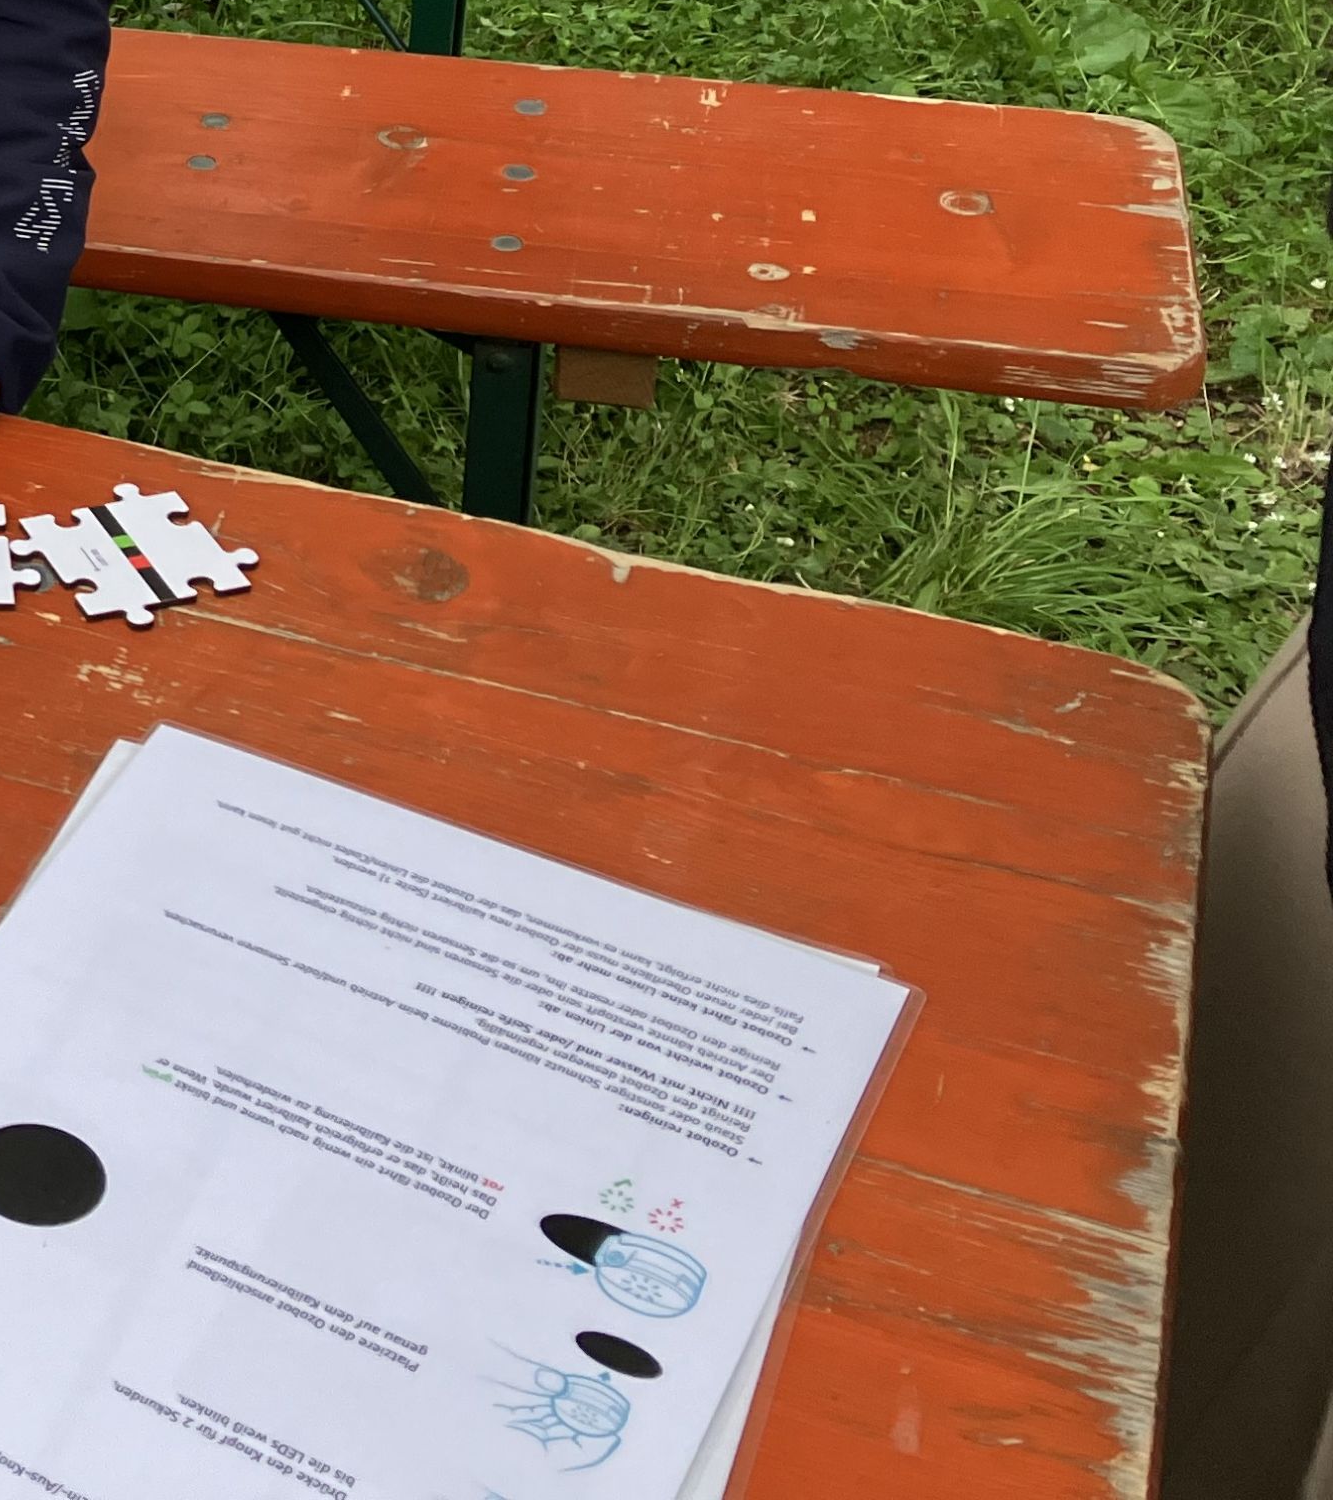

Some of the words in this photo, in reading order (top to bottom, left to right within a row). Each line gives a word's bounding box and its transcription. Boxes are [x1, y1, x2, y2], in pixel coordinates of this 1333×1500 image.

[549, 949, 574, 964] ab:
[575, 959, 612, 979] mehr
[613, 973, 657, 996] Linien
[439, 989, 496, 1019] reinigen
[536, 999, 561, 1015] ab:
[659, 990, 698, 1011] keine
[495, 1013, 533, 1033] Seife
[563, 1009, 606, 1033] Linien
[700, 1006, 738, 1026] fährt
[429, 1015, 491, 1045] Probleme
[534, 1026, 574, 1049] /oder
[607, 1027, 633, 1043] der
[741, 1021, 793, 1047] Ozobot
[492, 1039, 542, 1065] können
[574, 1043, 603, 1061] und
[636, 1037, 663, 1052] von
[155, 1055, 171, 1066] er
[551, 1046, 619, 1081] deswegen
[605, 1055, 657, 1082] Wasser
[664, 1048, 713, 1074] weicht
[170, 1062, 209, 1084] Wenn
[212, 1064, 293, 1105] wiederholen.
[543, 1059, 602, 1089] Schmutz
[658, 1076, 685, 1093] mit
[716, 1068, 769, 1095] Ozobot
[172, 1078, 211, 1101] blinkt
[207, 1078, 253, 1103] wurde.
[602, 1080, 667, 1114] sonstiger
[619, 1074, 669, 1101] Ozobot
[687, 1087, 730, 1110] Nicht
[211, 1095, 239, 1113] und
[253, 1097, 313, 1129] kalibriert
[294, 1098, 312, 1110] zu
[670, 1094, 698, 1112] den
[239, 1106, 277, 1127] vorne
[311, 1103, 393, 1146] Kalibrierung
[616, 1100, 683, 1135] reinigen:
[667, 1108, 701, 1128] oder
[699, 1103, 751, 1133] Reinigt
[276, 1122, 310, 1144] nach
[313, 1120, 386, 1159] erfolgreich
[684, 1129, 739, 1158] Ozobot
[702, 1121, 745, 1145] Staub
[310, 1134, 353, 1161] wenig
[385, 1152, 401, 1163] er
[391, 1138, 415, 1156] die
[415, 1148, 435, 1164] ist
[352, 1154, 376, 1172] ein
[401, 1159, 427, 1177] das
[375, 1164, 412, 1187] fährt
[427, 1167, 470, 1195] heißt,
[480, 1176, 505, 1193] rot
[411, 1179, 463, 1209] Ozobot
[469, 1187, 498, 1207] Das
[463, 1201, 491, 1220] Der
[184, 1259, 275, 1306] anschließend
[275, 1299, 327, 1330] Ozobot
[321, 1303, 354, 1324] dem
[327, 1323, 356, 1343] den
[355, 1318, 381, 1337] auf
[383, 1328, 429, 1356] genau
[356, 1336, 420, 1372] Platziere
[172, 1392, 231, 1427] blinken.
[181, 1415, 194, 1429] 2
[194, 1421, 218, 1440] für
[230, 1420, 268, 1445] weiß
[217, 1431, 264, 1462] Knopf
[268, 1438, 305, 1463] LEDs
[264, 1455, 294, 1477] den
[306, 1456, 331, 1476] die
[331, 1468, 356, 1488] bis
